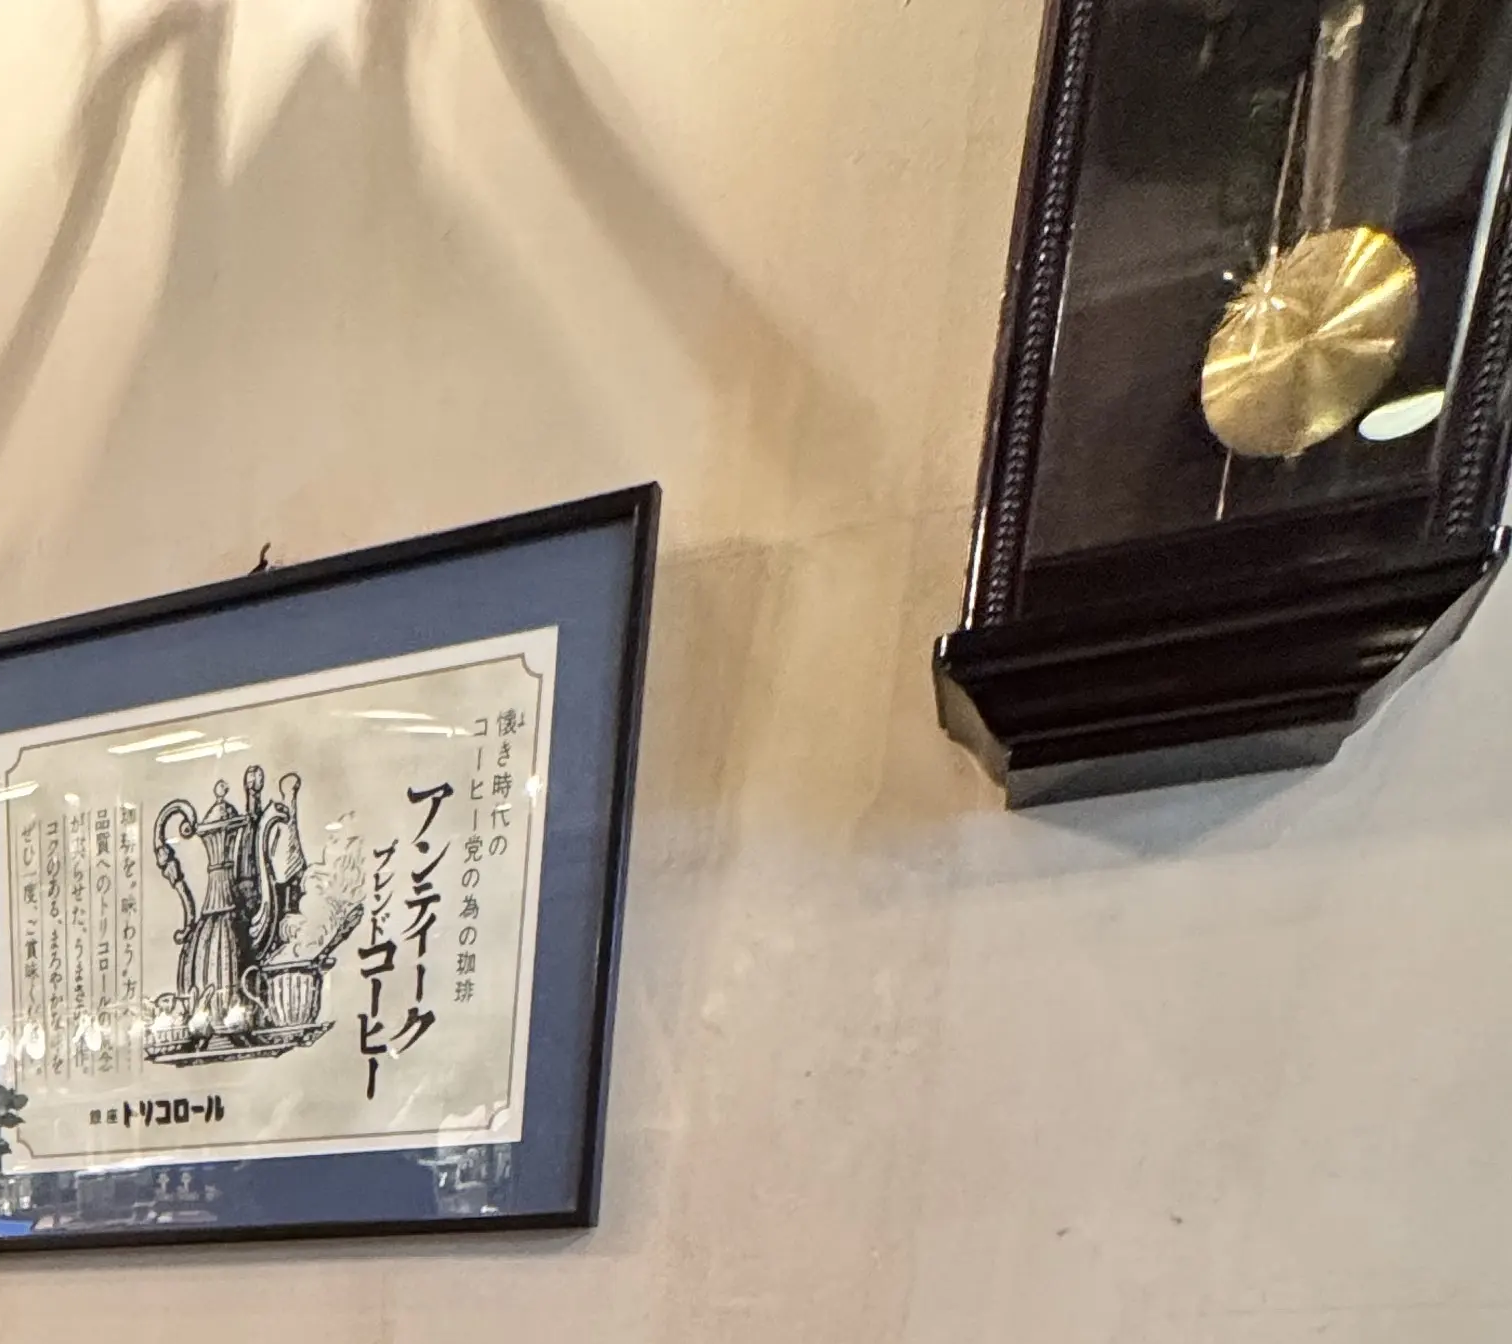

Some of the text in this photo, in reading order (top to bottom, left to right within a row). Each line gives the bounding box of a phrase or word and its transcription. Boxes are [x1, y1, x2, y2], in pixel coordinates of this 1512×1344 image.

[390, 781, 454, 1054] アンティーク
[454, 717, 488, 1003] コーヒー党の為の珈琲
[123, 1095, 225, 1128] トリコロール
